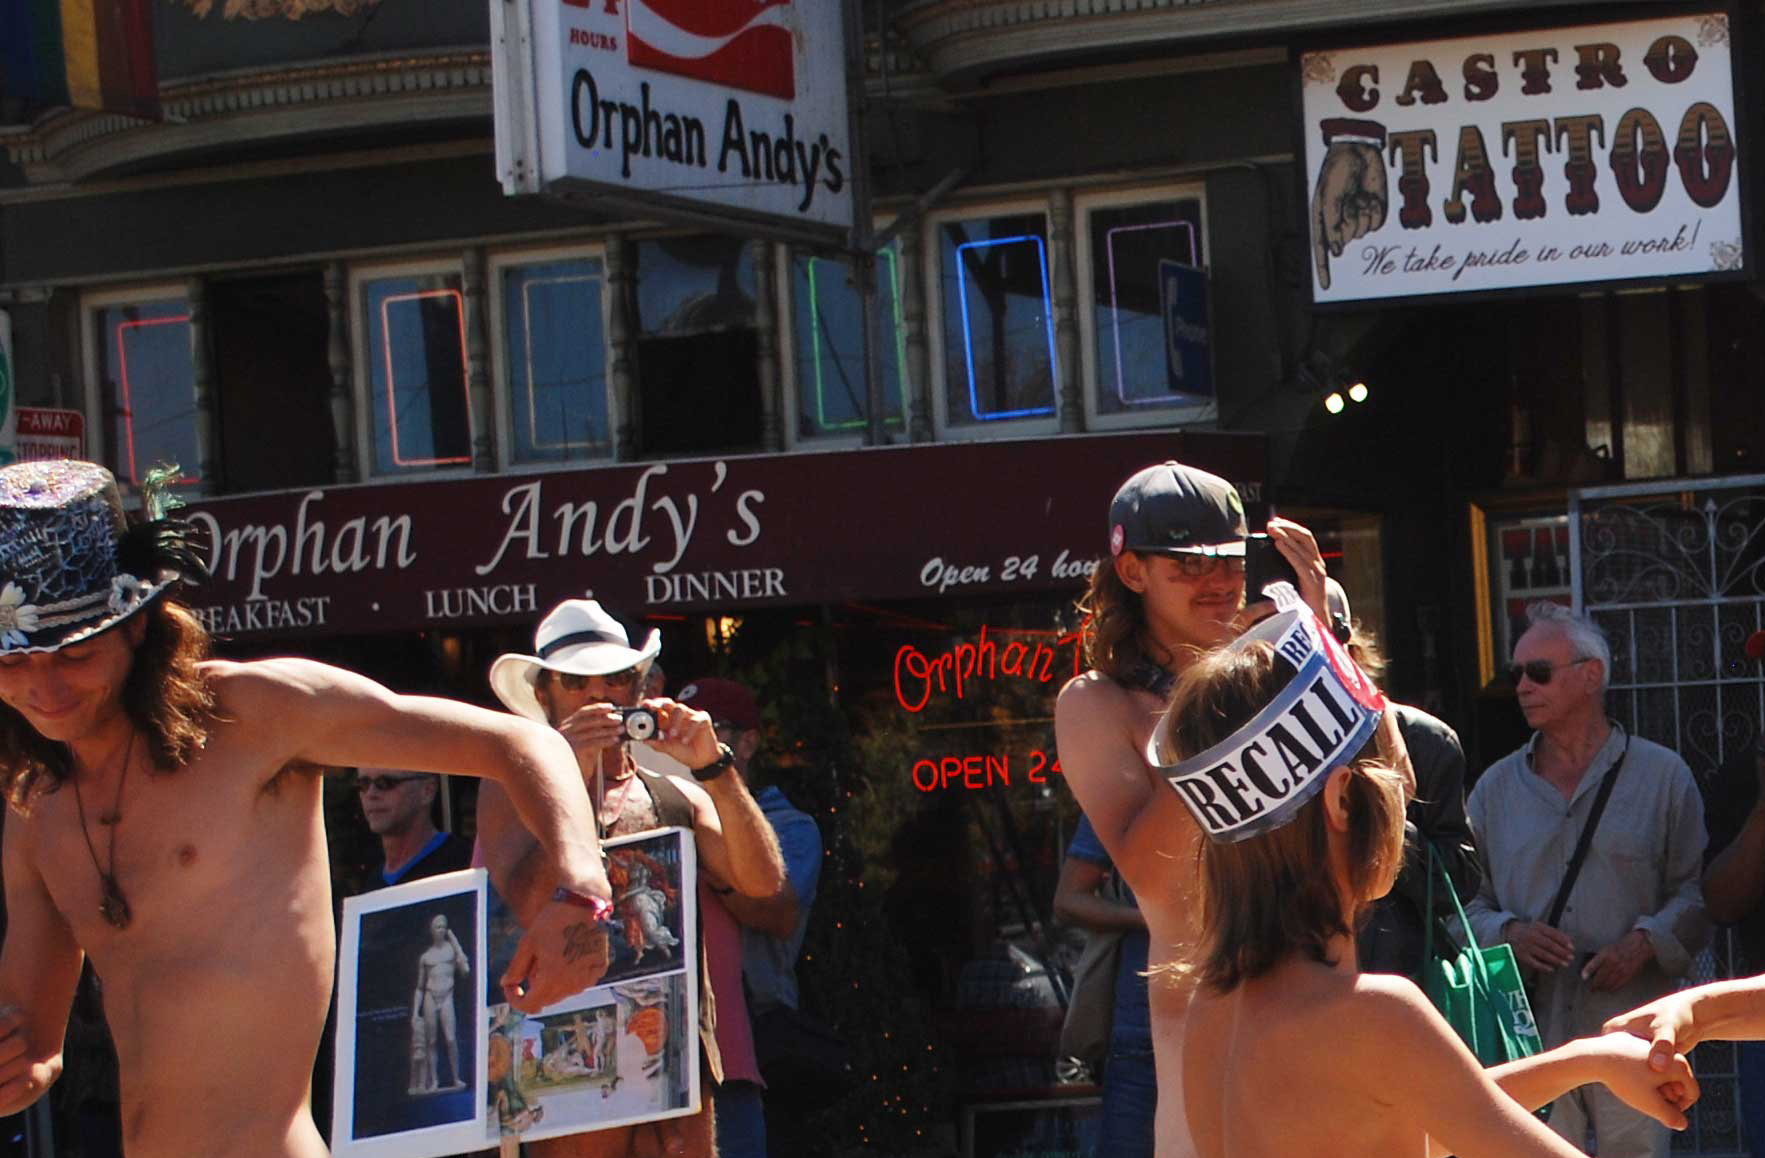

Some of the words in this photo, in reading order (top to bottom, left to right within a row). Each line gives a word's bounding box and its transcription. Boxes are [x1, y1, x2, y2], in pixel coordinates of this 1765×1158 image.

[569, 28, 617, 51] HOURS
[1336, 35, 1698, 112] CASTRO
[571, 67, 706, 178] Orphan
[718, 98, 843, 211] Andy's
[1388, 102, 1736, 229] TATTOO
[1361, 244, 1397, 276] We
[1403, 240, 1455, 272] take
[1452, 238, 1529, 281] pride
[1534, 247, 1562, 263] in
[1570, 242, 1615, 261] our
[1622, 219, 1702, 257] work!
[475, 460, 765, 576] Andy's
[425, 584, 538, 618] LUNCH
[644, 568, 787, 604] DINNER
[920, 557, 989, 593] Open
[1001, 555, 1039, 581] 24
[895, 624, 1055, 713] Orphan
[912, 754, 1010, 792] OPEN
[1176, 676, 1359, 830] RECALL
